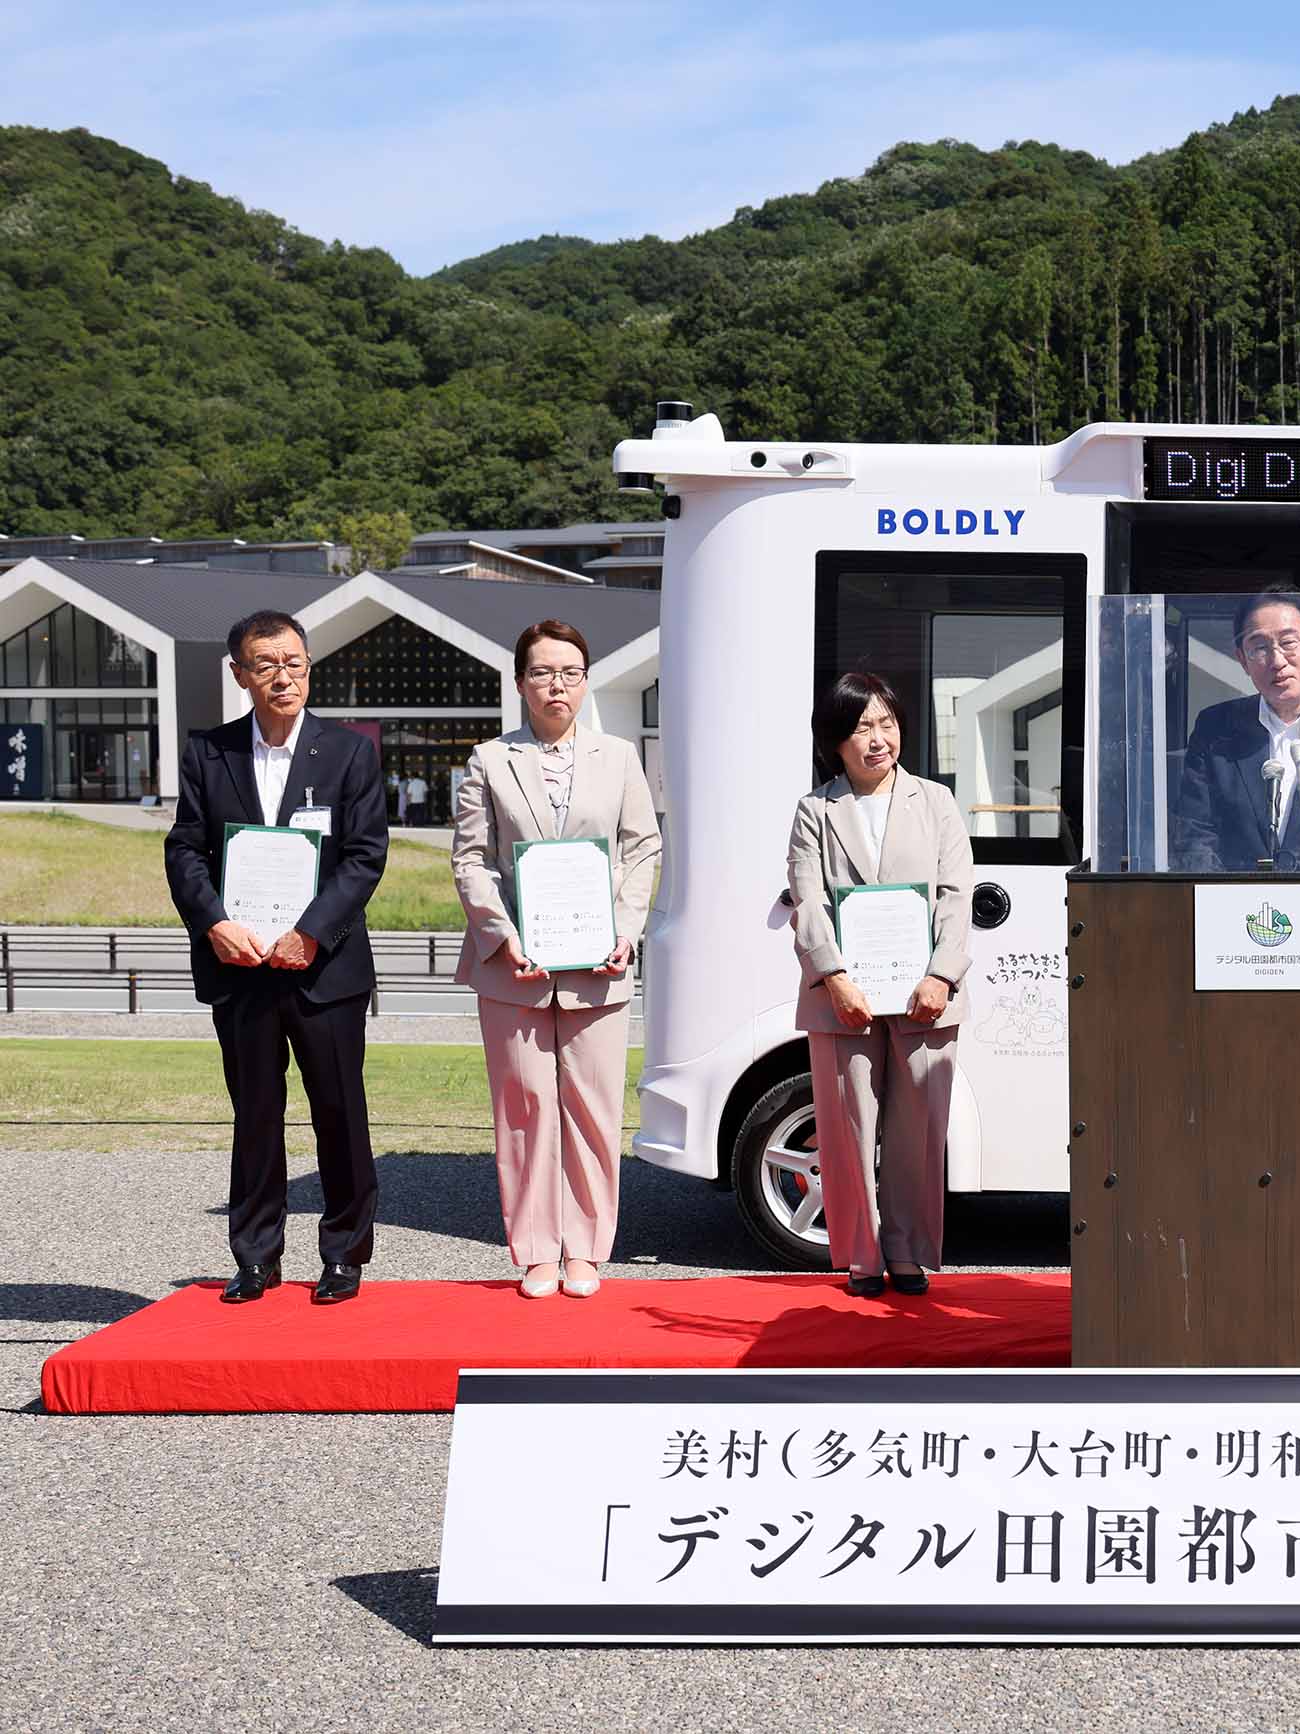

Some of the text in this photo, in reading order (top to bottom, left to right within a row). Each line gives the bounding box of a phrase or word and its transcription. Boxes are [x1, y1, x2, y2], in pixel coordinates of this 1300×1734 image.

[1167, 451, 1246, 497] Digi
[877, 509, 1026, 536] BOLDLY
[997, 953, 1060, 970] ふるさとむら
[986, 968, 1067, 985] どうぶつパー
